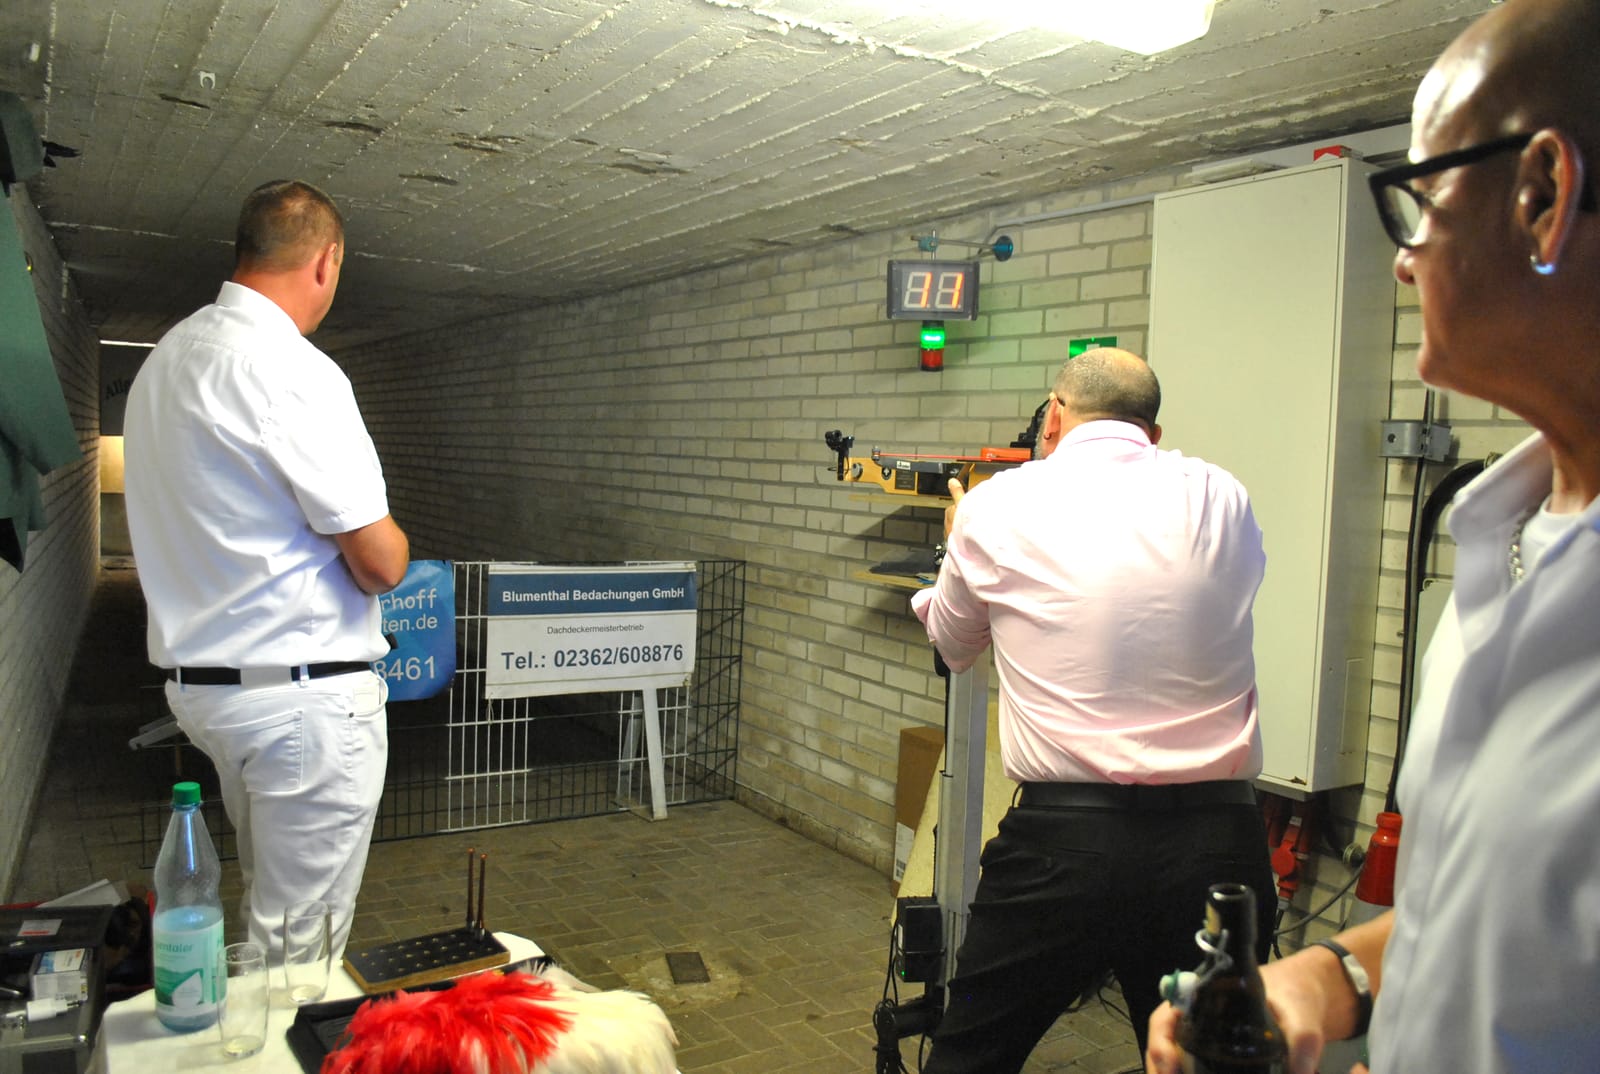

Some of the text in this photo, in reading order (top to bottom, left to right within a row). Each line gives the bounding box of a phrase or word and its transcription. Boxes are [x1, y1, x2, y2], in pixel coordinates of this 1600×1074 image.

[918, 271, 964, 309] 11
[381, 588, 437, 611] rhoff
[502, 587, 684, 602] Blumenthal Bedachungen GmbH
[383, 613, 438, 633] ten.de
[547, 624, 645, 635] Dachdeckermeisterbetrieb
[501, 644, 683, 670] Tel.: 02362/608876
